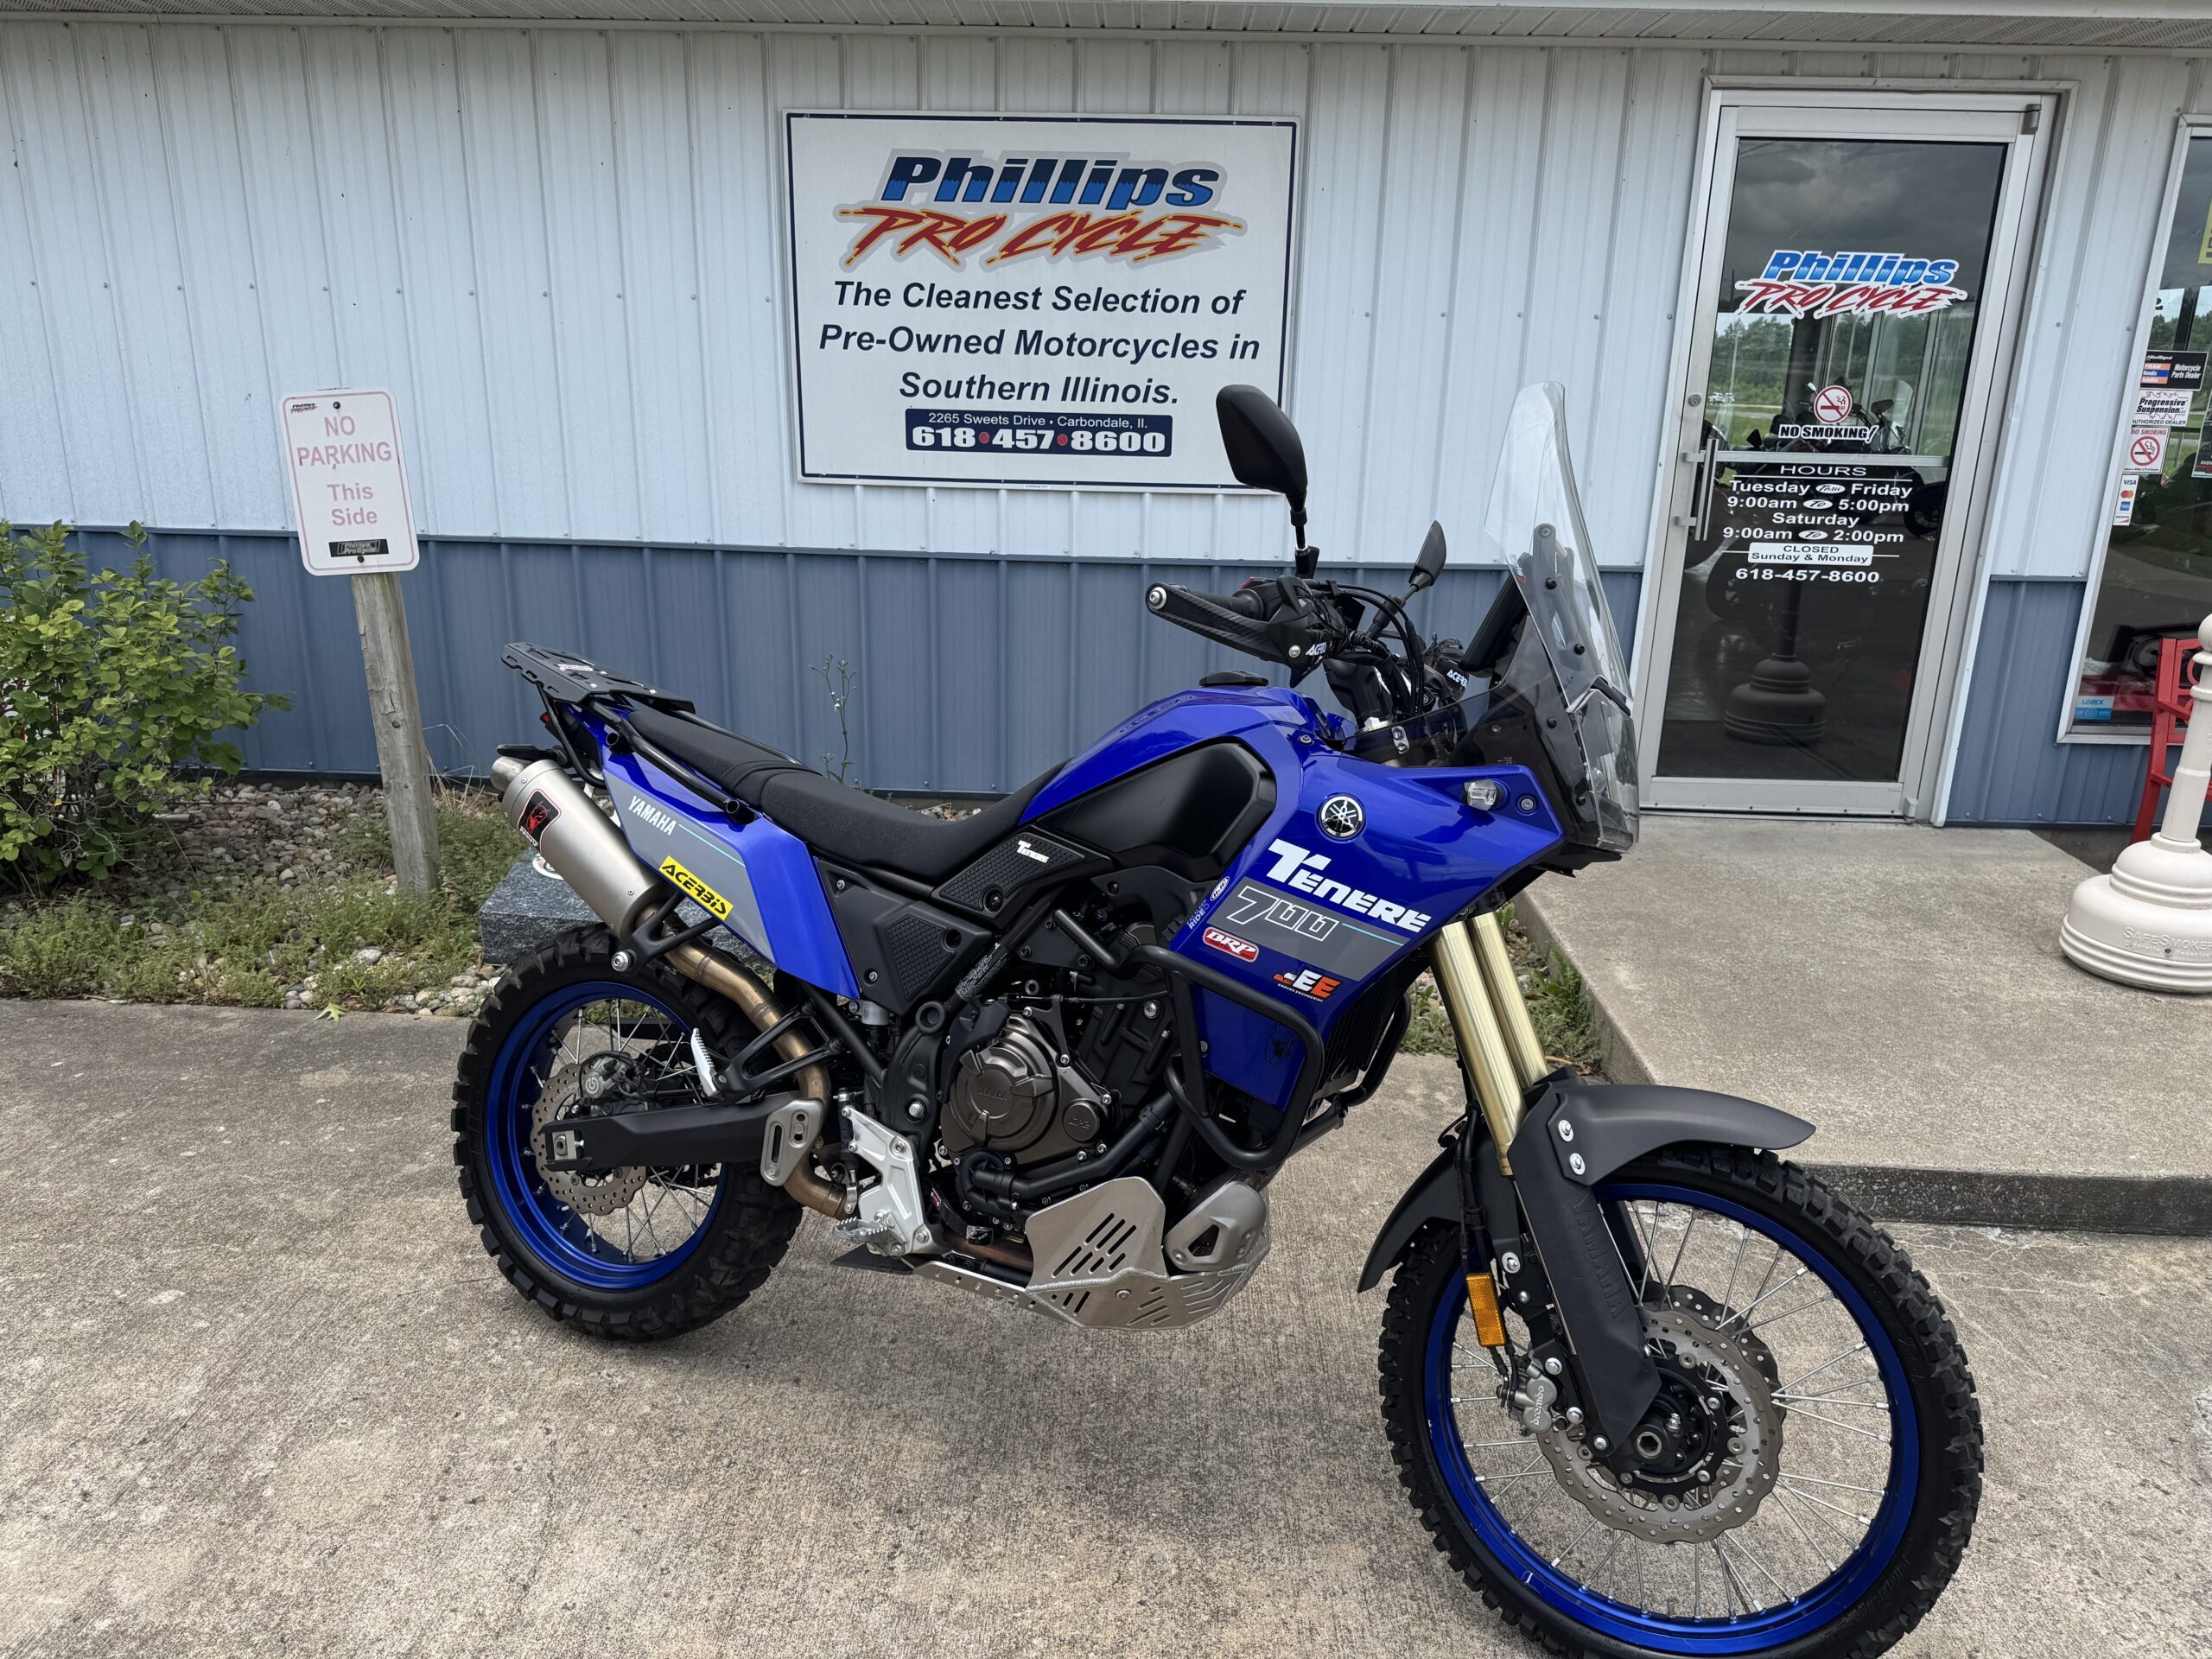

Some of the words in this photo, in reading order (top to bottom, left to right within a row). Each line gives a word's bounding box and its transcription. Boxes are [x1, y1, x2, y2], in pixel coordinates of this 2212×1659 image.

[880, 156, 1219, 210] Phillips
[838, 207, 1007, 265] PRO
[985, 210, 1243, 264] CYCLE
[1763, 251, 1959, 285] Phillips
[834, 281, 892, 307] The
[902, 283, 1042, 311] Cleanest
[1052, 285, 1201, 314] Selection
[1211, 289, 1246, 315] of
[1737, 282, 1834, 317] PRO
[1816, 284, 1966, 318] CYCLE
[819, 324, 1005, 356] Pre-Owned
[1014, 330, 1219, 365] Motorcycles
[1229, 334, 1260, 360] in
[2174, 364, 2201, 372] Motorcycle
[899, 372, 1049, 402] Southern
[1061, 377, 1179, 404] Illinois.
[2136, 405, 2180, 414] Suspension
[2139, 397, 2186, 407] Progressive
[324, 415, 356, 436] NO
[928, 412, 960, 424] 2265
[963, 413, 1009, 425] Sweets
[1013, 415, 1046, 426] Drive
[1057, 416, 1131, 429] Carbondale,
[1779, 424, 1802, 438] NO
[296, 442, 392, 467] PARKING
[1780, 465, 1867, 477] HOURS
[327, 483, 373, 501] This
[1729, 480, 1811, 496] Tuesday
[1850, 481, 1913, 499] Friday
[1727, 496, 1797, 509] 9:00am
[1838, 499, 1910, 513] 5:00pm
[331, 508, 378, 526] Side
[1772, 512, 1859, 528] Saturday
[1722, 527, 1793, 540] 9:00am
[1833, 530, 1904, 543] 2:00pm
[1751, 552, 1801, 563] Sunday
[1803, 553, 1813, 562] &
[1817, 554, 1869, 564] Monday
[1783, 544, 1840, 554] CLOSED
[1735, 568, 1879, 583] 618-457-8600
[626, 795, 677, 836] YAMAHA
[1188, 908, 1206, 930] RIDE
[1227, 885, 1339, 942] 700
[1206, 931, 1256, 955] BRP
[1530, 1385, 1545, 1426] brembo
